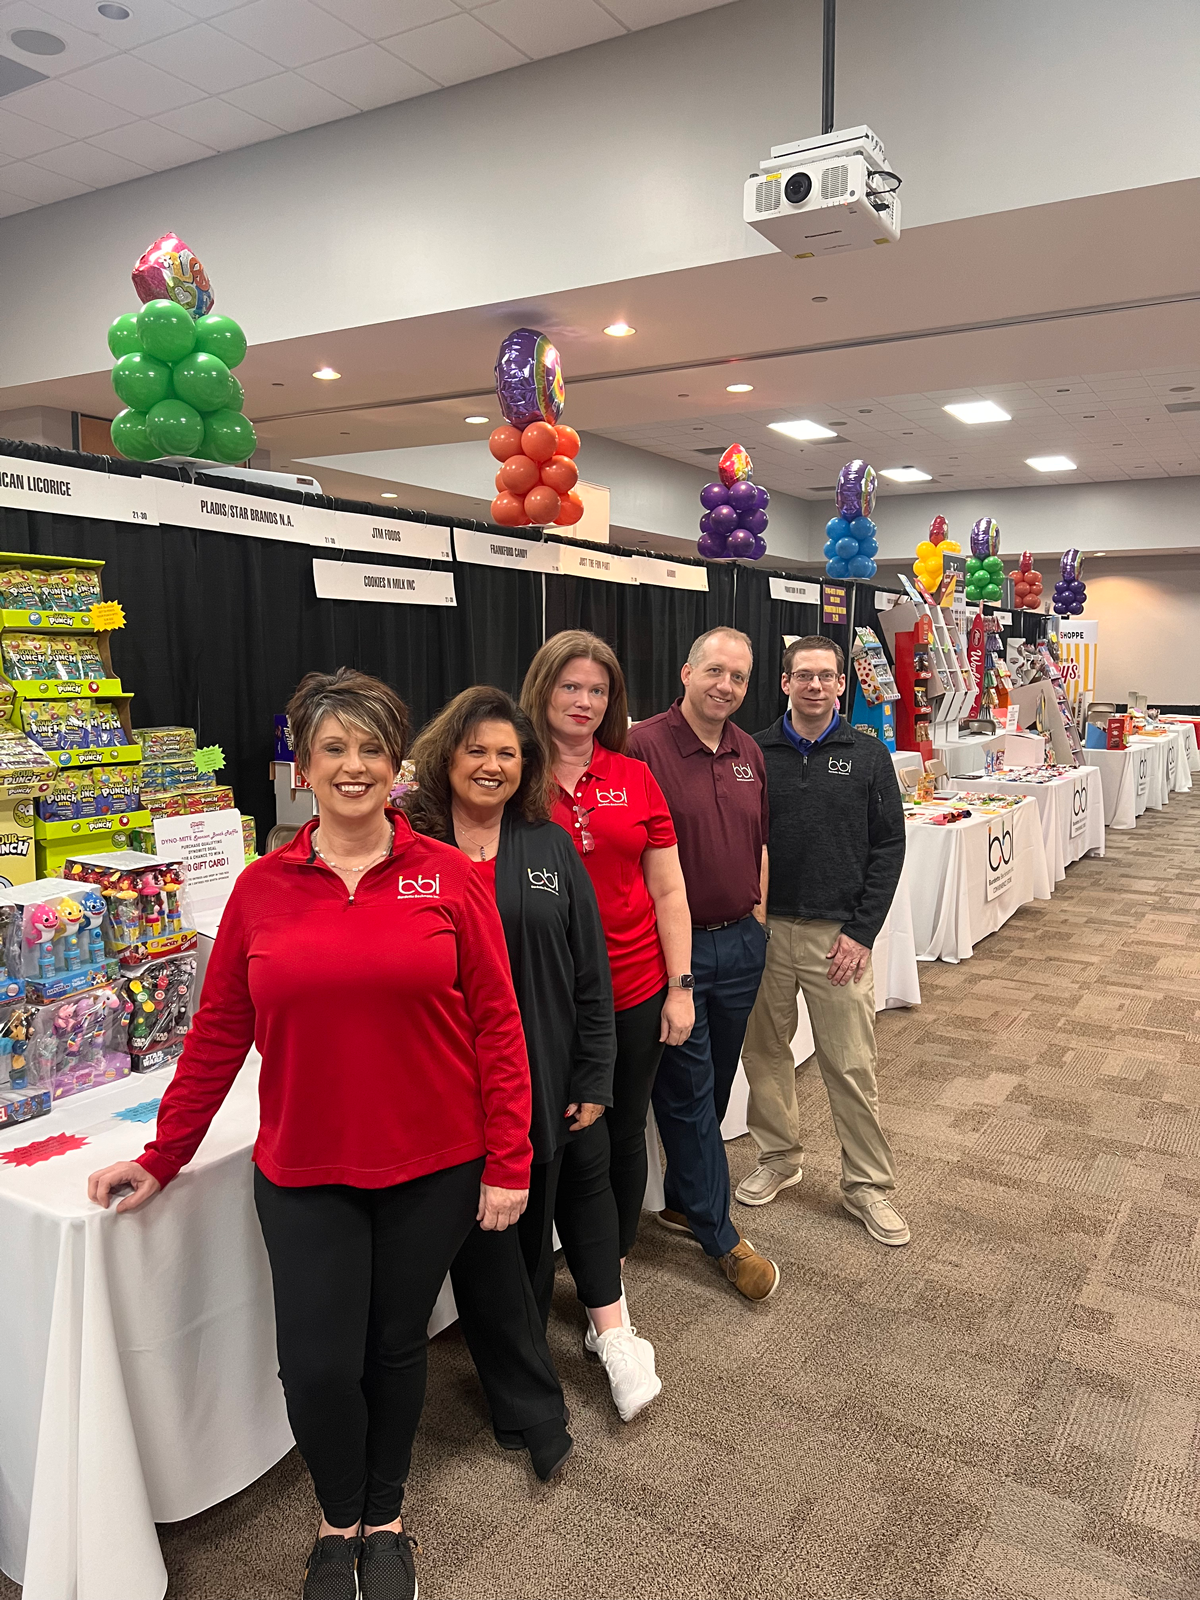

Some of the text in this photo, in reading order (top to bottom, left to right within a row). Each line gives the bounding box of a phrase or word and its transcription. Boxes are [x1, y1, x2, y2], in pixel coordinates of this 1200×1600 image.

[0, 472, 72, 497] ICAN LICORICE
[132, 511, 148, 520] 21-30
[200, 500, 295, 527] PLADIS/STAR BRANDS N.A.
[371, 527, 401, 542] JTM FOODS
[490, 544, 528, 559] FRANKFORD CANDY
[363, 575, 416, 591] COOKIES N MILK INC
[9, 586, 35, 596] PUNC
[76, 585, 97, 595] UNCH
[47, 617, 74, 627] PUNCH
[1059, 631, 1085, 640] SHOPPE
[14, 654, 46, 662] PUNCH
[56, 686, 83, 695] PUNCH
[78, 754, 104, 764] PUNCH
[828, 756, 852, 773] bbi
[731, 762, 754, 779] bbi
[2, 775, 41, 786] PUNCH
[8, 788, 32, 796] PUNCH
[101, 786, 131, 798] PUNCH
[596, 787, 628, 804] bbi
[46, 793, 78, 804] PUNCH
[88, 821, 112, 832] PUNCH
[0, 832, 19, 844] OUR
[161, 835, 192, 845] DYNO-MITE
[0, 841, 30, 857] NCH
[181, 839, 223, 850] PURCHASE QUALIFYING
[192, 861, 208, 871] GIFT
[208, 858, 226, 869] CARD
[398, 873, 440, 895] bbi
[527, 867, 559, 892] bbi
[146, 1051, 164, 1060] STAR
[143, 1056, 164, 1067] WARS
